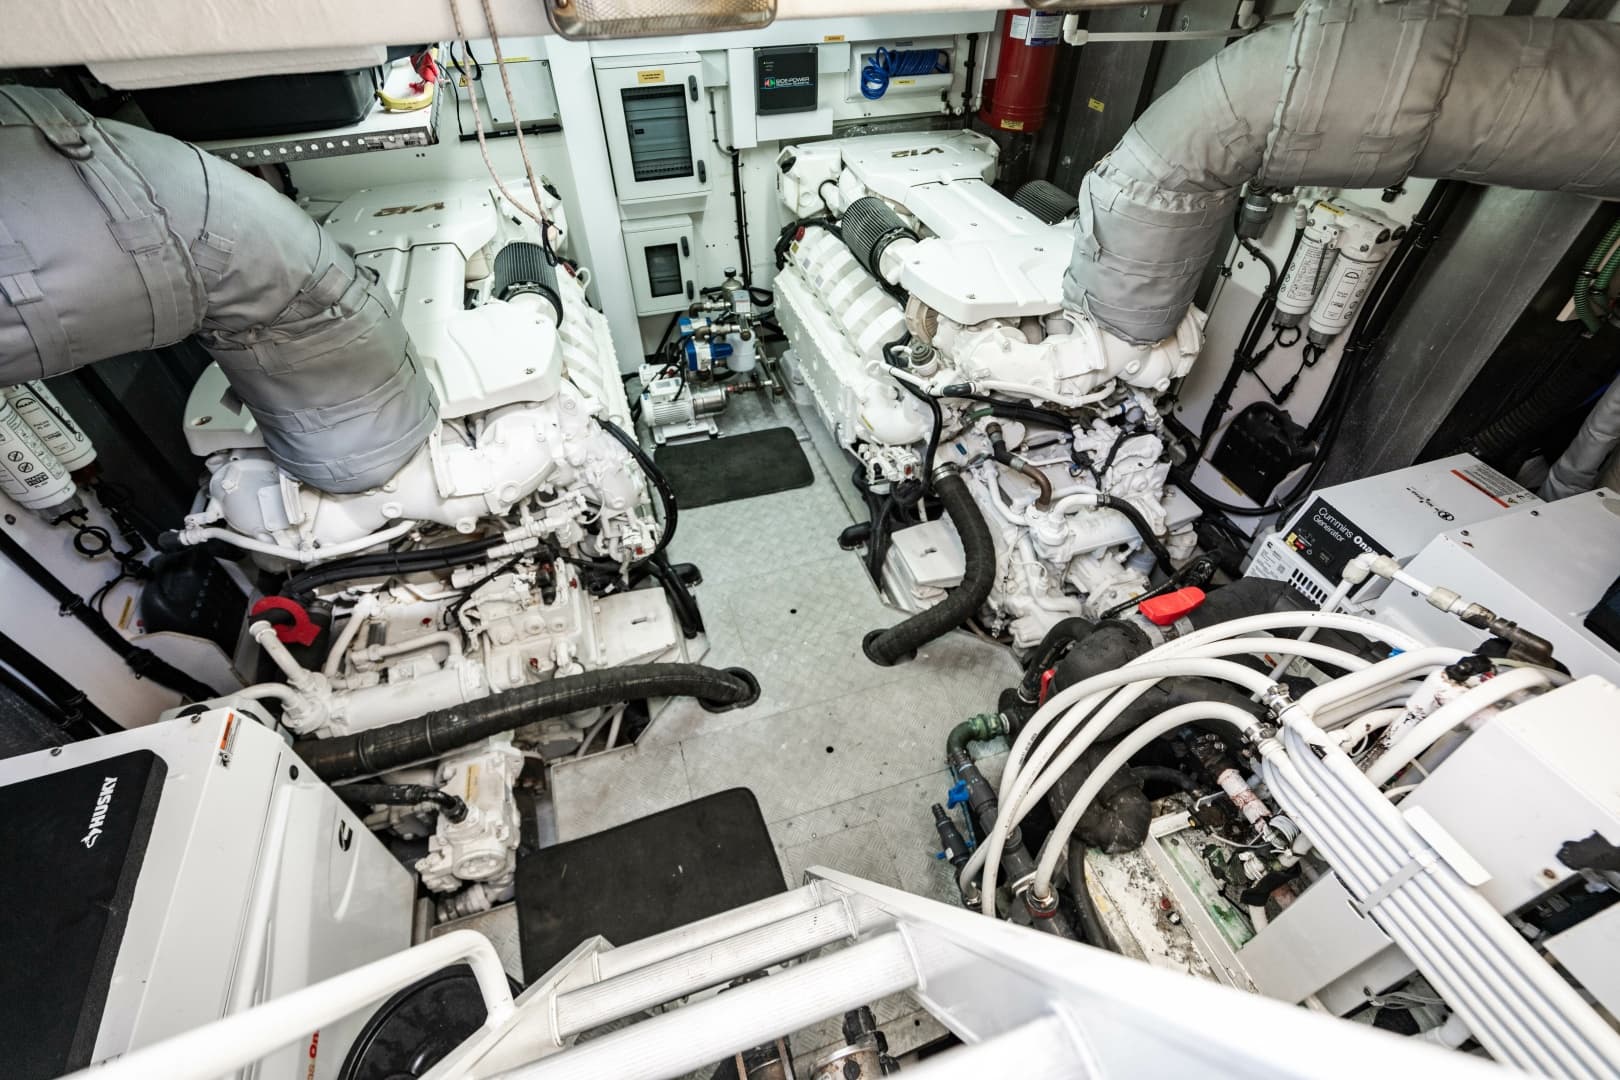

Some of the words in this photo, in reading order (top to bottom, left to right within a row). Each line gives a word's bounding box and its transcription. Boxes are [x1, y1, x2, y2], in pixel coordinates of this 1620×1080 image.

[1313, 514, 1345, 542] Generator
[1318, 507, 1354, 539] Cummins
[1353, 535, 1374, 554] Ona
[88, 776, 118, 829] HUSKY
